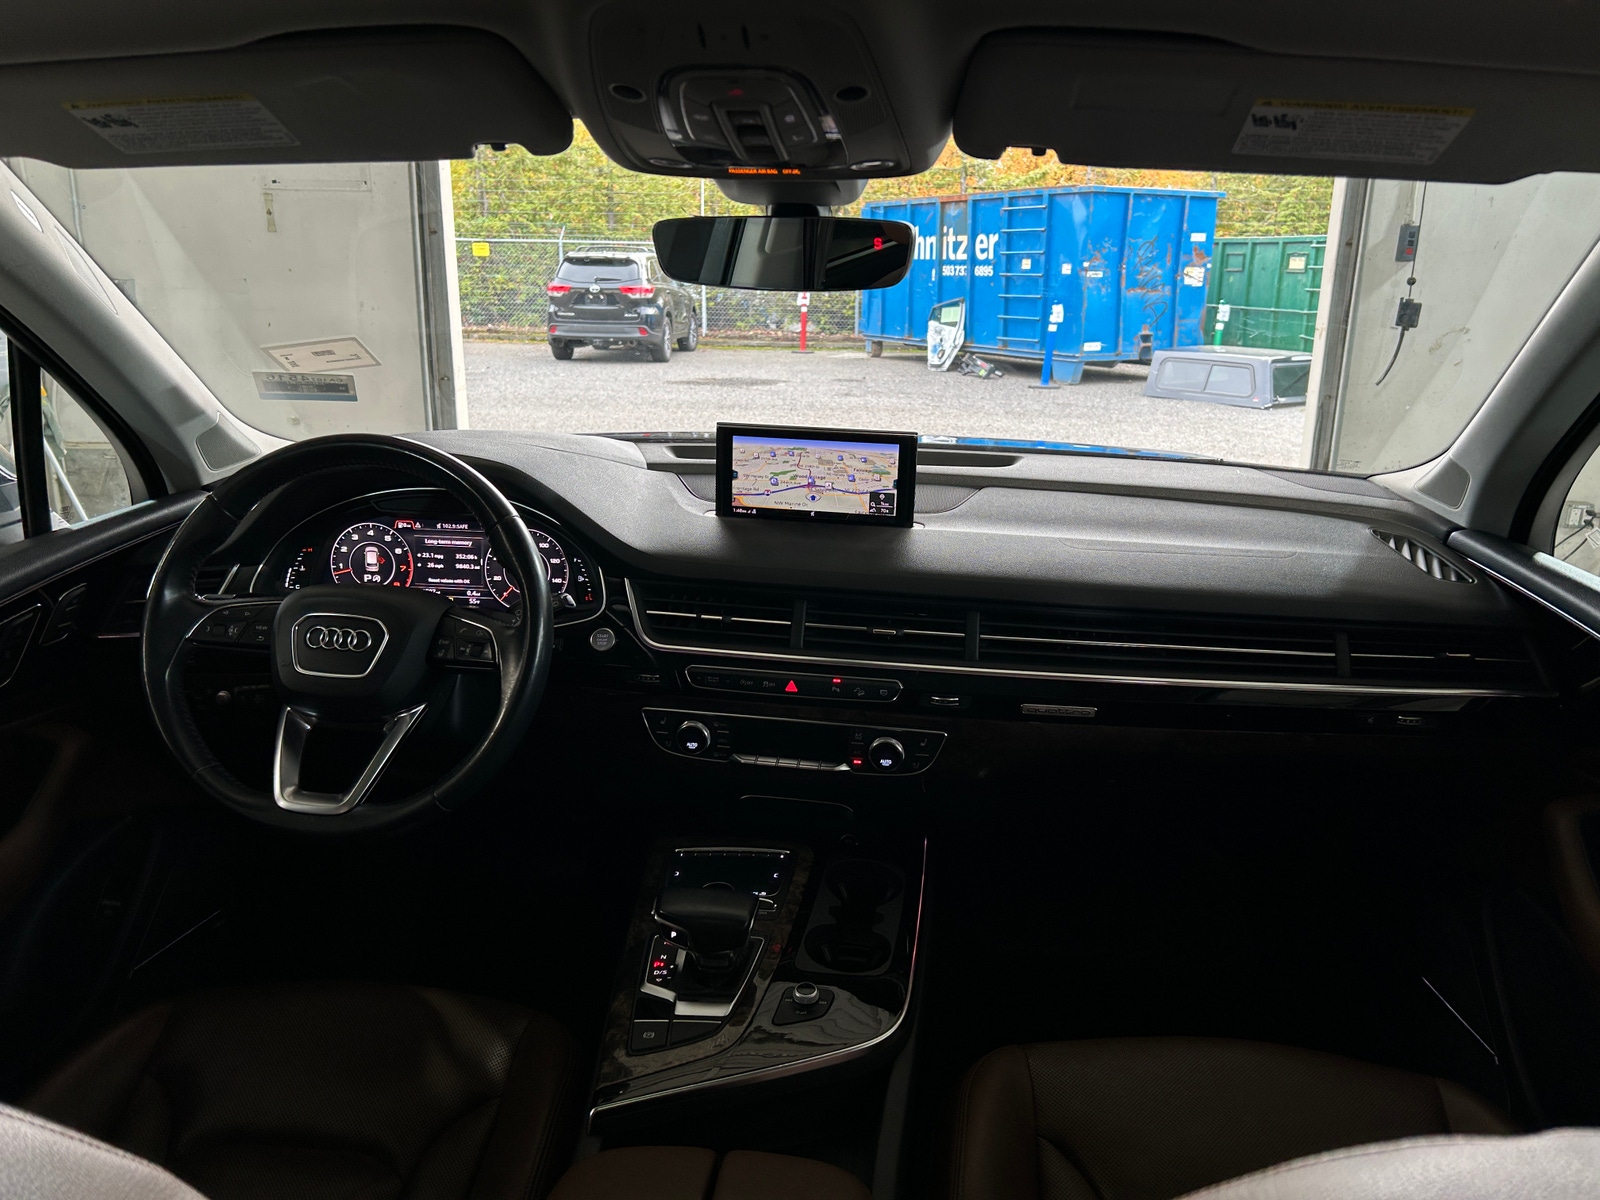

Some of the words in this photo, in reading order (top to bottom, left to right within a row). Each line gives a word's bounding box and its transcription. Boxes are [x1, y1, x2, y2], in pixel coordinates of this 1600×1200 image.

[351, 533, 359, 541] 3
[363, 574, 372, 583] P
[1027, 707, 1091, 715] quattro
[670, 931, 677, 939] P
